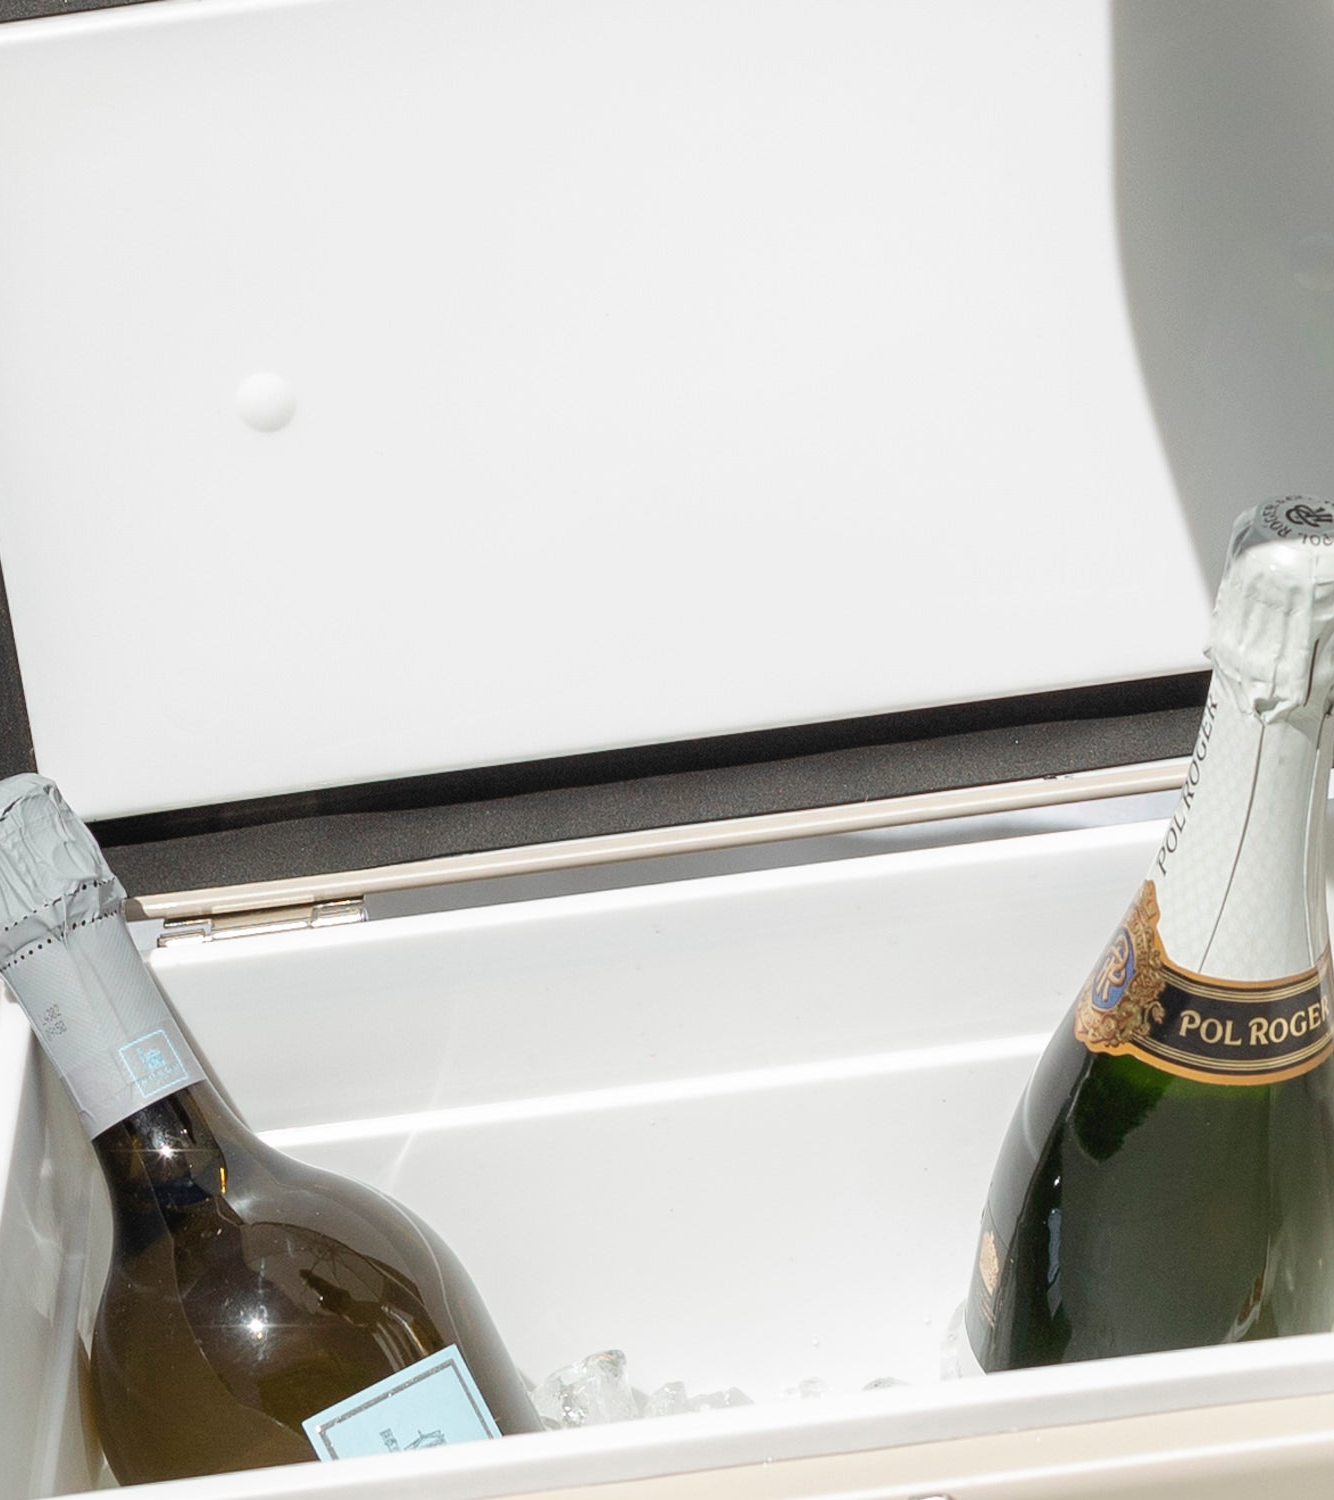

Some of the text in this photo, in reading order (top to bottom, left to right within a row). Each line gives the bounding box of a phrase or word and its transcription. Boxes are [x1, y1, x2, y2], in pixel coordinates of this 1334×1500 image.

[1155, 698, 1219, 876] POL ROGER
[1178, 994, 1331, 1046] POL ROGER
